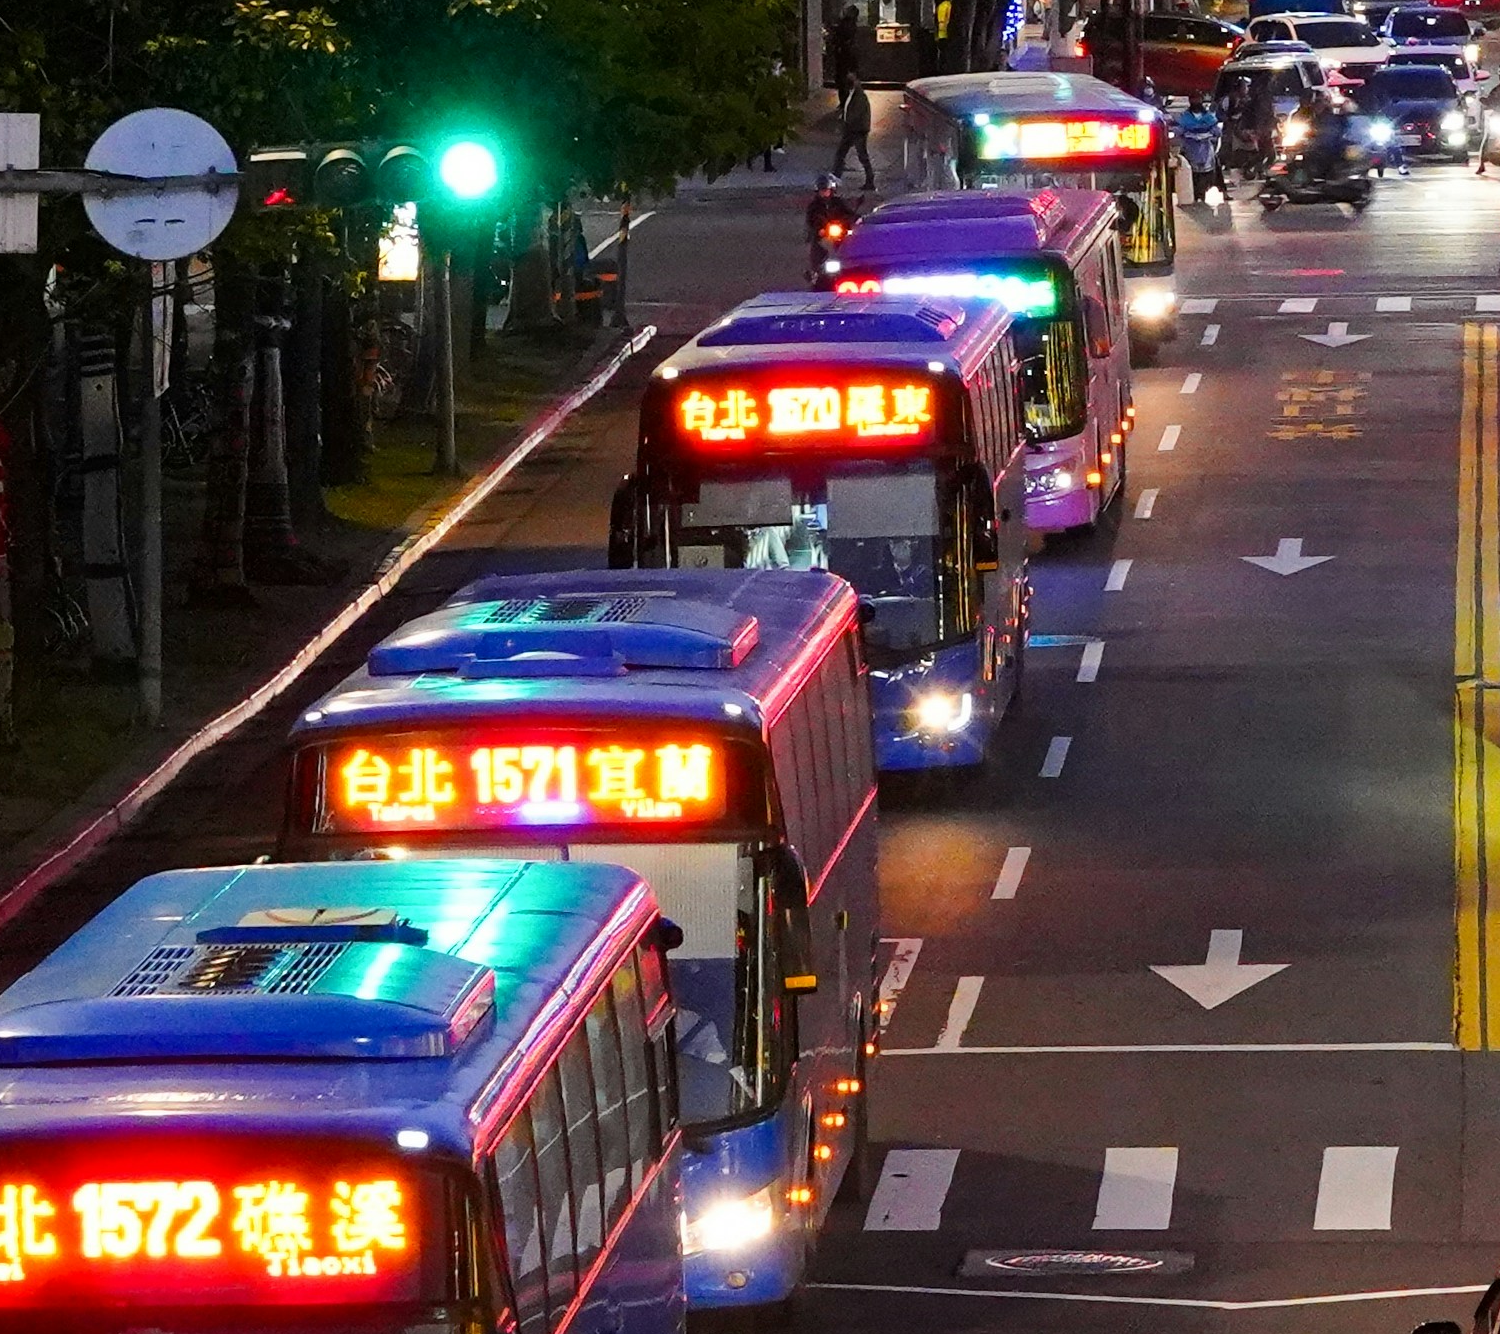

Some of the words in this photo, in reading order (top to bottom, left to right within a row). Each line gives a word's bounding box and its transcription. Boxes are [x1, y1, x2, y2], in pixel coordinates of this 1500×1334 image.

[681, 389, 759, 430] 台北
[342, 749, 456, 805] 台北
[471, 746, 577, 804] 1571
[586, 744, 712, 801] 宜蘭
[73, 1180, 222, 1258] 1572
[232, 1179, 406, 1253] 礁溪
